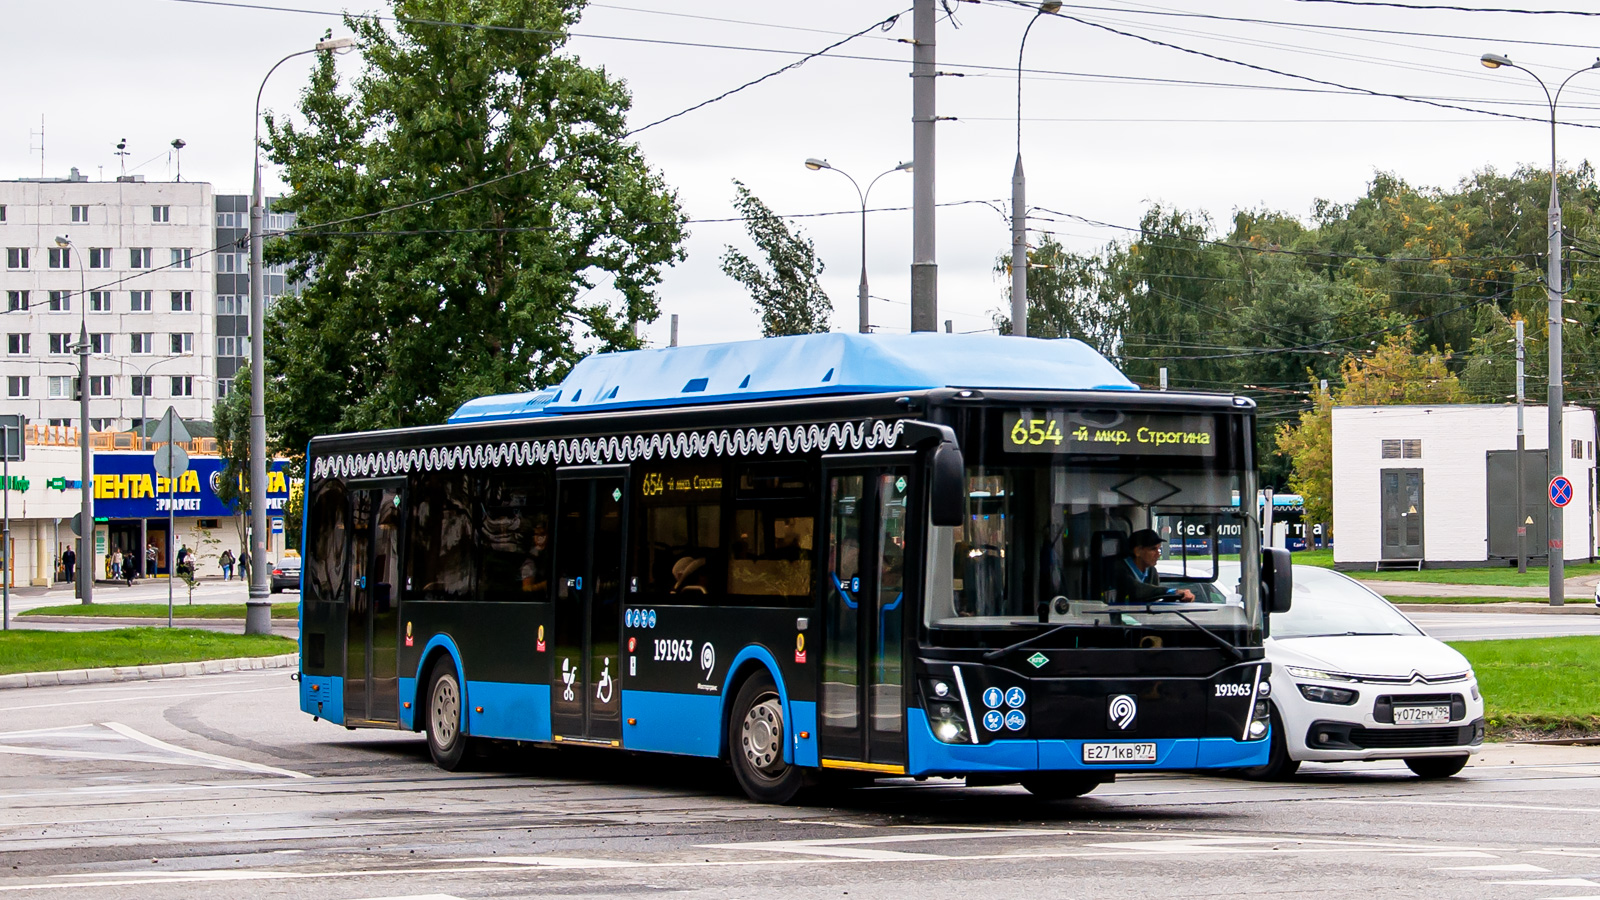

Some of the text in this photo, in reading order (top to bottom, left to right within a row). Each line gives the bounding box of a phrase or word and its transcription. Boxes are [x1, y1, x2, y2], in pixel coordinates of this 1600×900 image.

[1011, 419, 1063, 445] 654
[1094, 431, 1131, 445] мкр.
[1136, 426, 1210, 446] Строгина
[643, 473, 663, 495] 654
[654, 639, 693, 661] 191963
[1215, 683, 1251, 697] 191963
[1434, 706, 1447, 716] 799
[1087, 744, 1153, 759] Е271КВ 977
